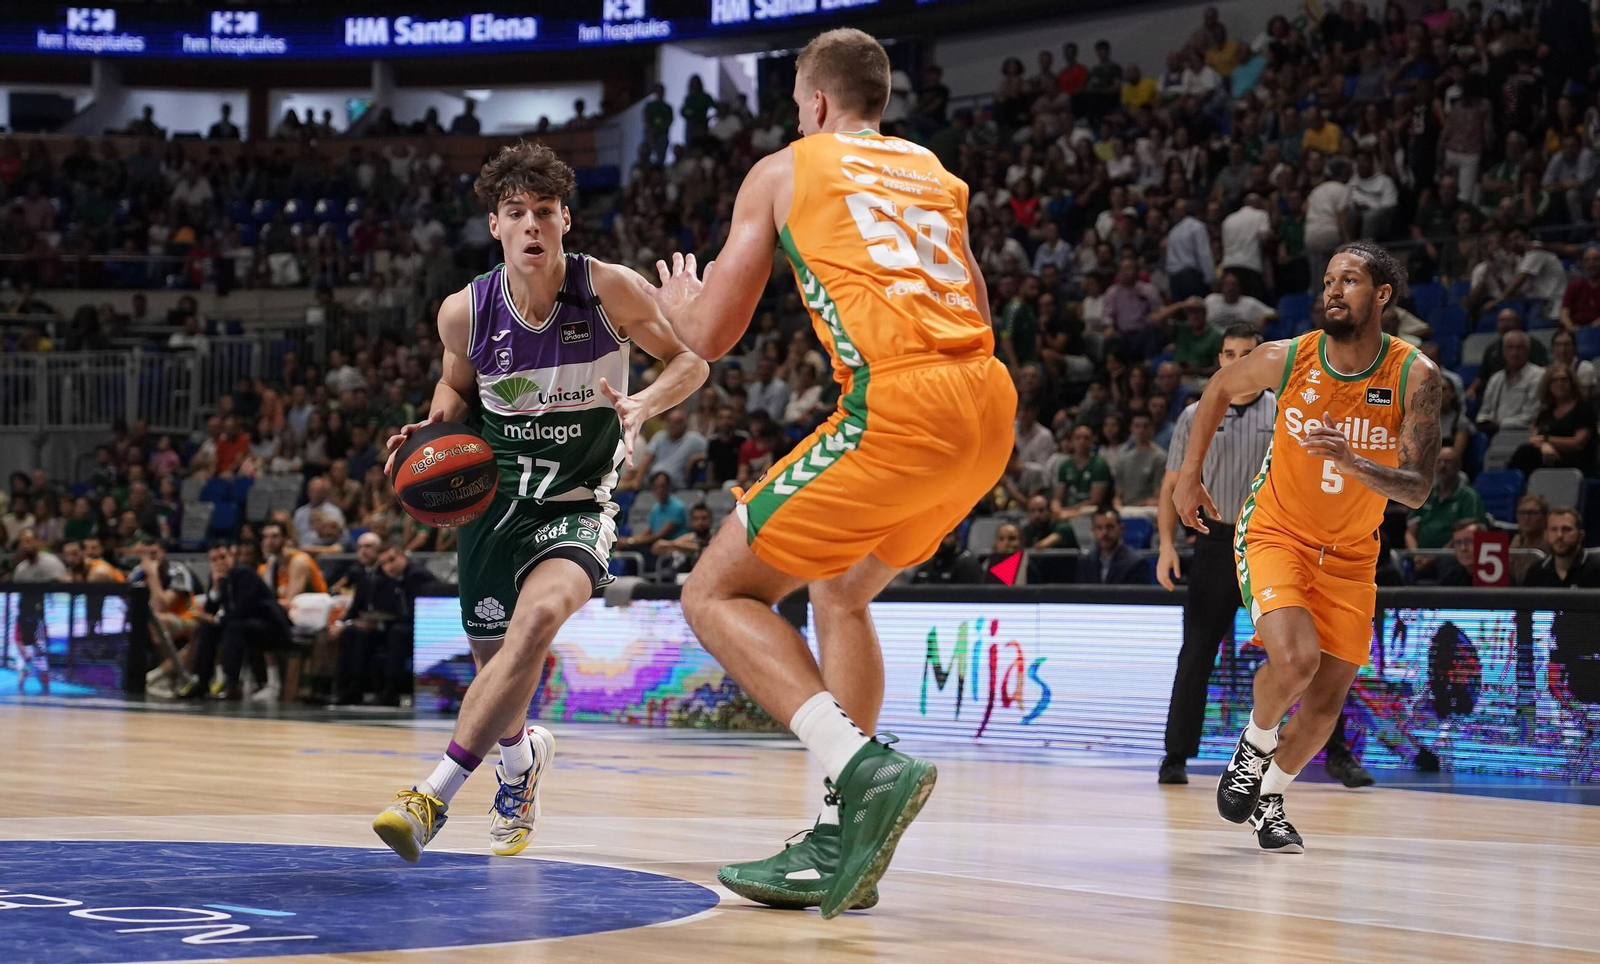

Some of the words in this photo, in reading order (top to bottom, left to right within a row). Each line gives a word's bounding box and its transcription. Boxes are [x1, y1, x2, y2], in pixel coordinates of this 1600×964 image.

[66, 32, 145, 53] hospitales
[211, 34, 287, 56] hospitales
[345, 17, 389, 46] HM
[394, 15, 465, 45] Santa
[470, 12, 536, 42] Elena
[603, 18, 671, 42] hospitales
[844, 192, 970, 285] 50
[538, 384, 595, 405] Unicaja
[503, 421, 582, 445] málaga
[410, 447, 436, 476] liga
[434, 443, 484, 461] endesa
[422, 472, 493, 509] SPALDING
[517, 455, 561, 500] 17
[1320, 459, 1345, 495] 5
[1476, 541, 1505, 583] 5
[919, 616, 1051, 739] Mijas
